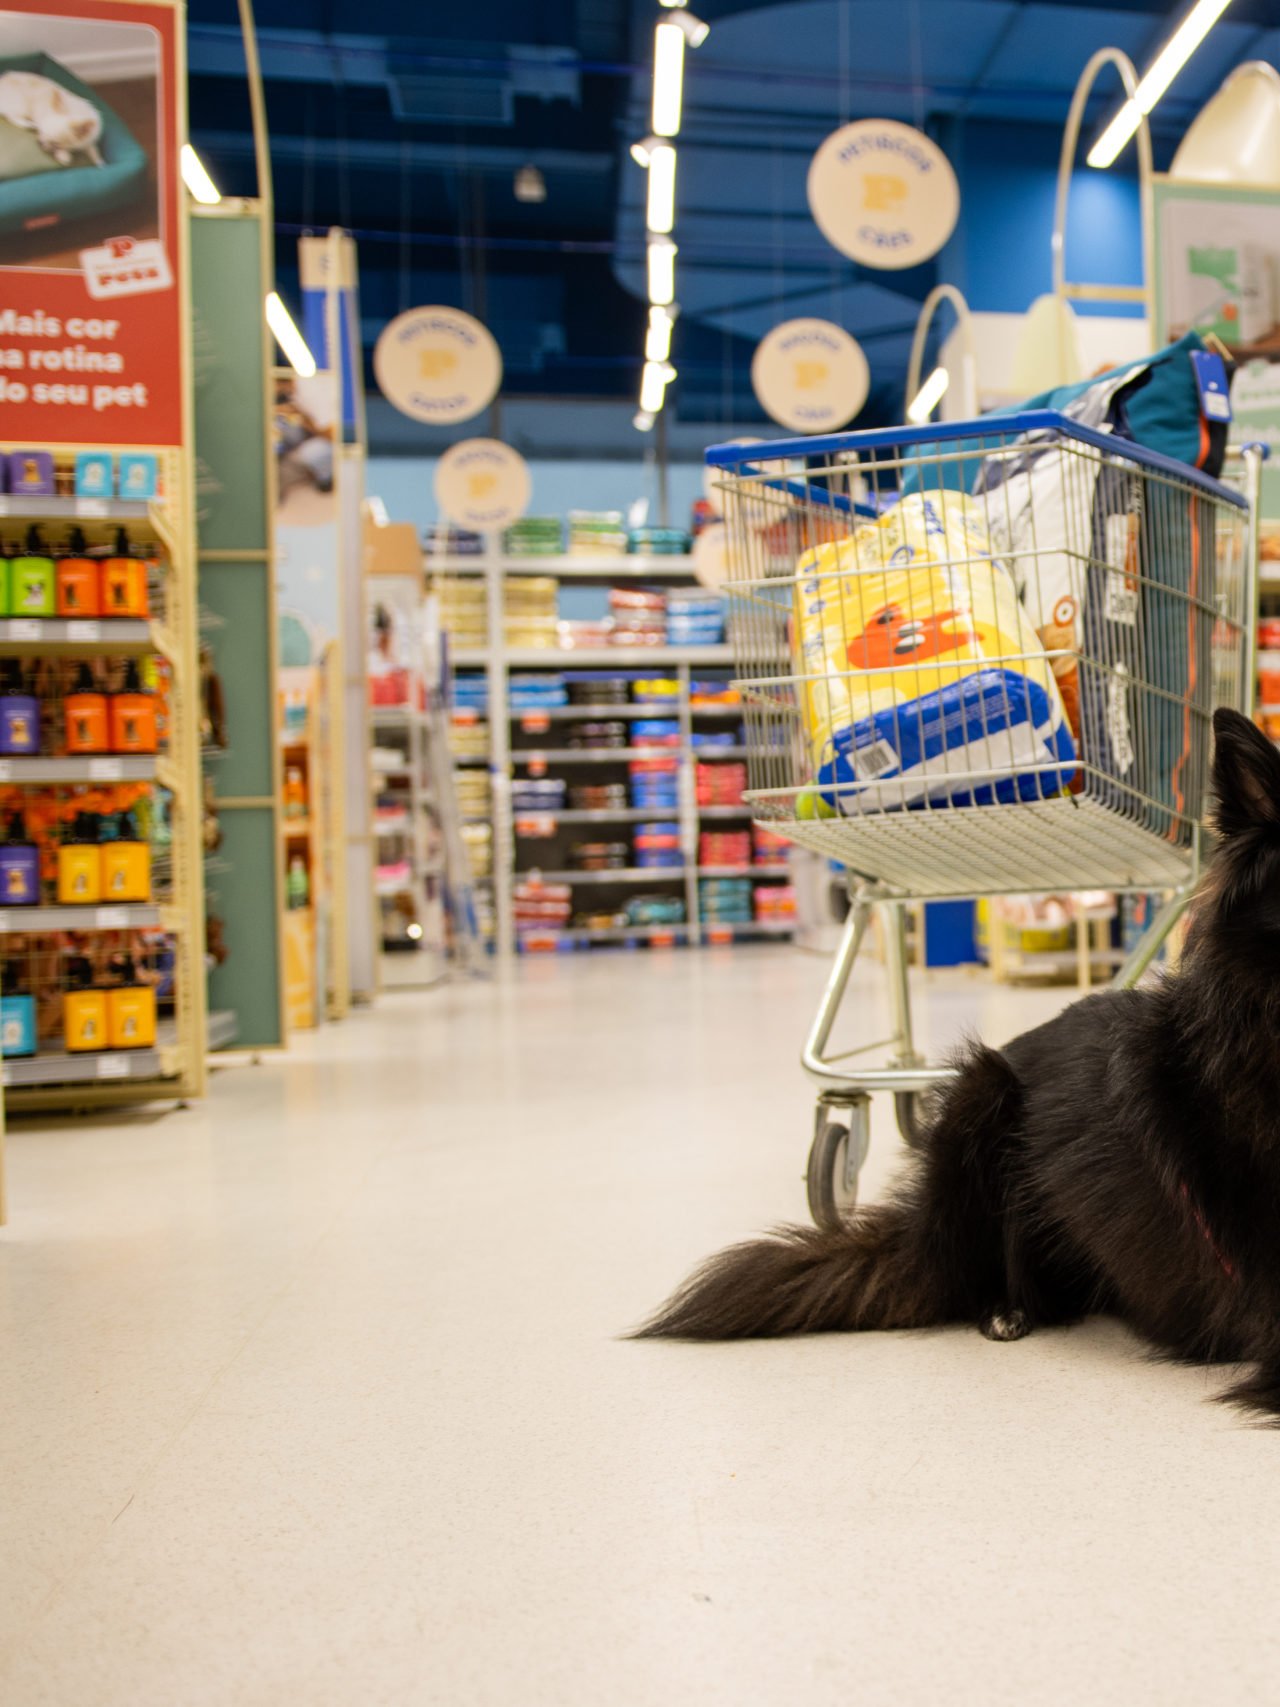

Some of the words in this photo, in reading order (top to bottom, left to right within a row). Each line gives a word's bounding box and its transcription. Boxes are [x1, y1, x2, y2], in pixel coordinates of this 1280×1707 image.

[66, 317, 121, 341] cor
[0, 349, 24, 369] a
[29, 344, 125, 373] rotina
[32, 382, 89, 405] seu
[92, 381, 148, 411] pet
